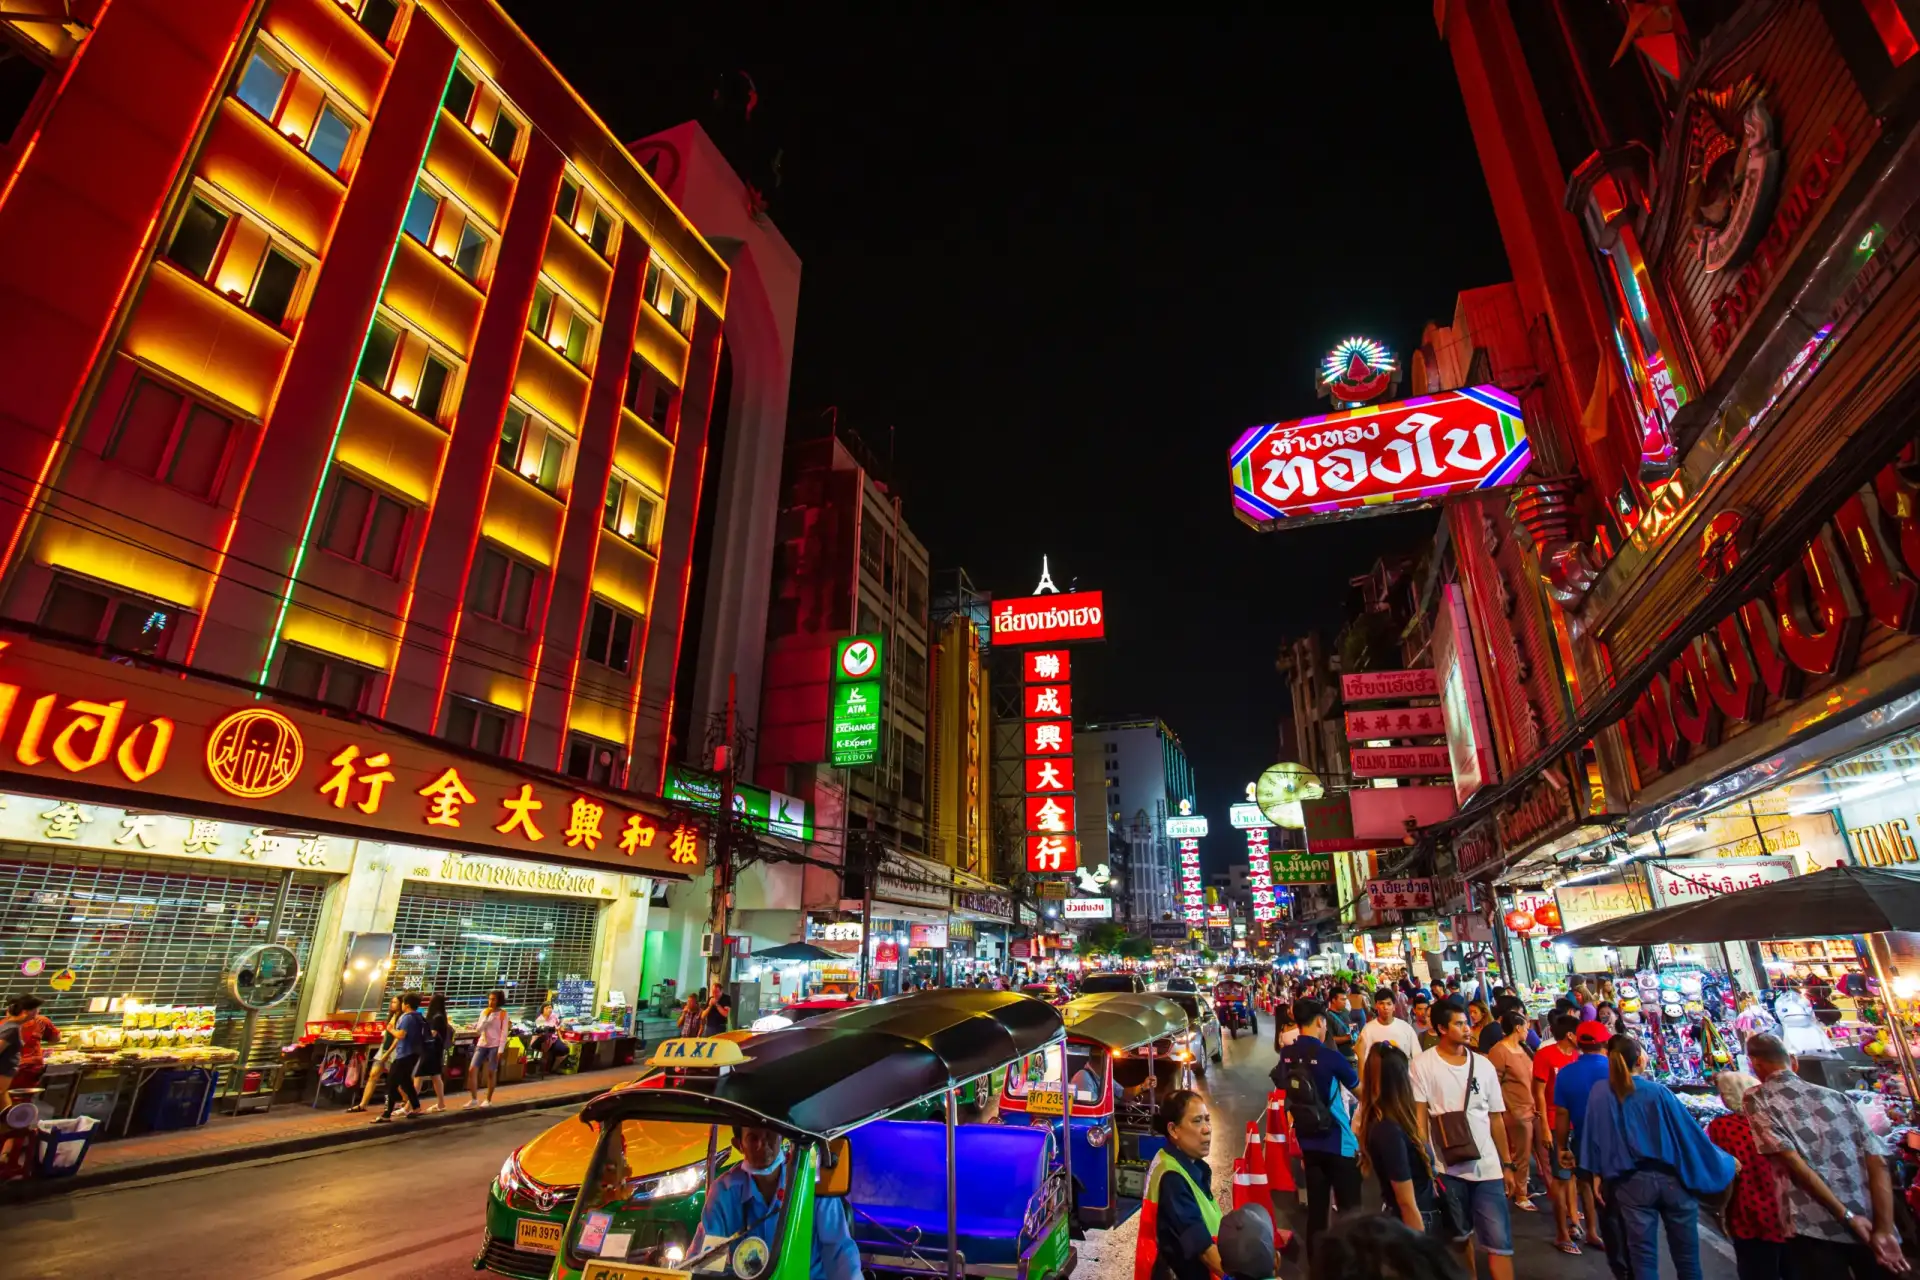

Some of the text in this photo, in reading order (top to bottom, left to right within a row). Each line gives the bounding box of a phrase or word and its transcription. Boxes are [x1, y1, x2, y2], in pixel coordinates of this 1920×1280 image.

[1270, 422, 1380, 456] ห้างทอง
[1261, 412, 1498, 501] ทองใบ
[994, 605, 1102, 633] เลี่ยงเซ่งเฮง
[847, 705, 867, 714] ATM
[836, 723, 876, 733] EXCHANGE
[836, 736, 872, 748] K-Expert
[835, 753, 873, 762] WISDOM
[1034, 655, 1066, 870] 聯成興大金行
[1357, 755, 1386, 769] SIANG
[1388, 754, 1416, 768] HENG
[1419, 753, 1440, 768] HUA
[1848, 817, 1918, 867] TONG
[664, 1042, 718, 1058] TAXI
[539, 1226, 560, 1241] 3979
